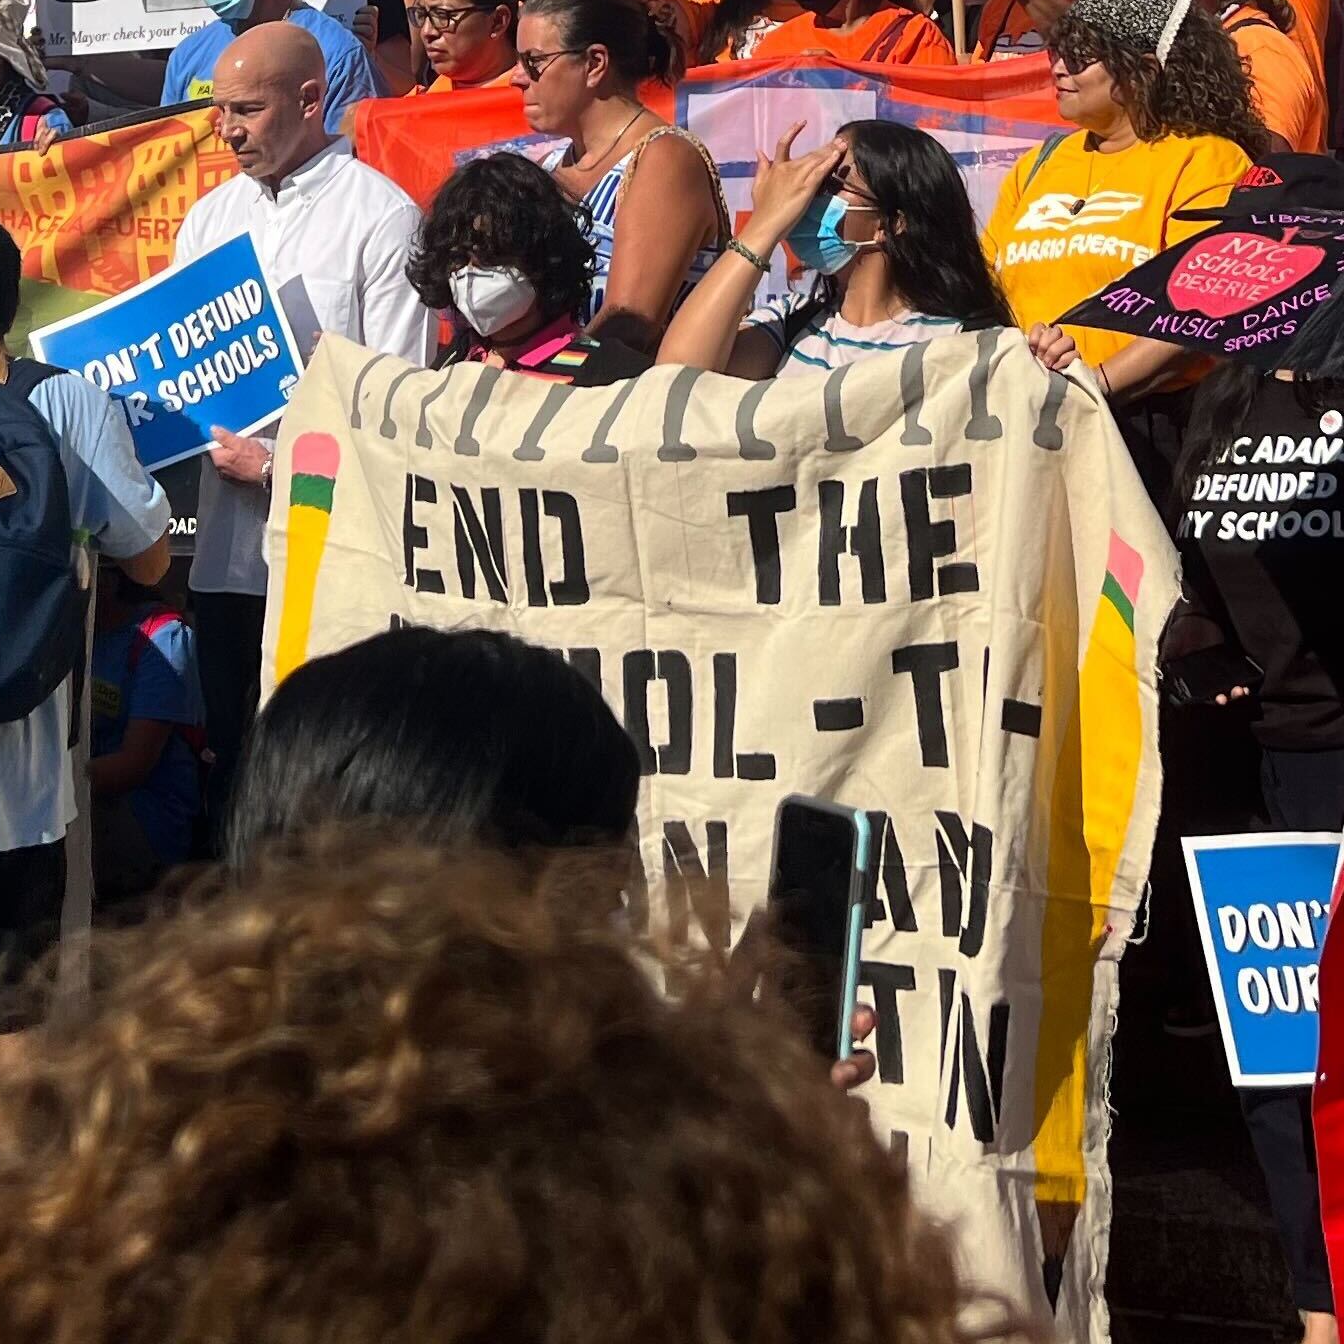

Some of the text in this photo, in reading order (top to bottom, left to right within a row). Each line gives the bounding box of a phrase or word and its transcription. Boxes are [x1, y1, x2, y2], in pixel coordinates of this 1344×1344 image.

[112, 25, 146, 42] check
[147, 26, 177, 42] your
[1188, 252, 1296, 285] SCHOOLS
[1220, 237, 1297, 263] NYC
[1174, 272, 1270, 301] DESERVE
[167, 278, 264, 359] DEFUND
[1100, 283, 1332, 331] ART DANCE
[1148, 314, 1298, 353] MUSIC SPORTS
[157, 325, 280, 412] SCHOOLS
[1191, 472, 1338, 502] DEFUNDED
[401, 462, 983, 607] END THE
[1237, 962, 1320, 1015] OUR
